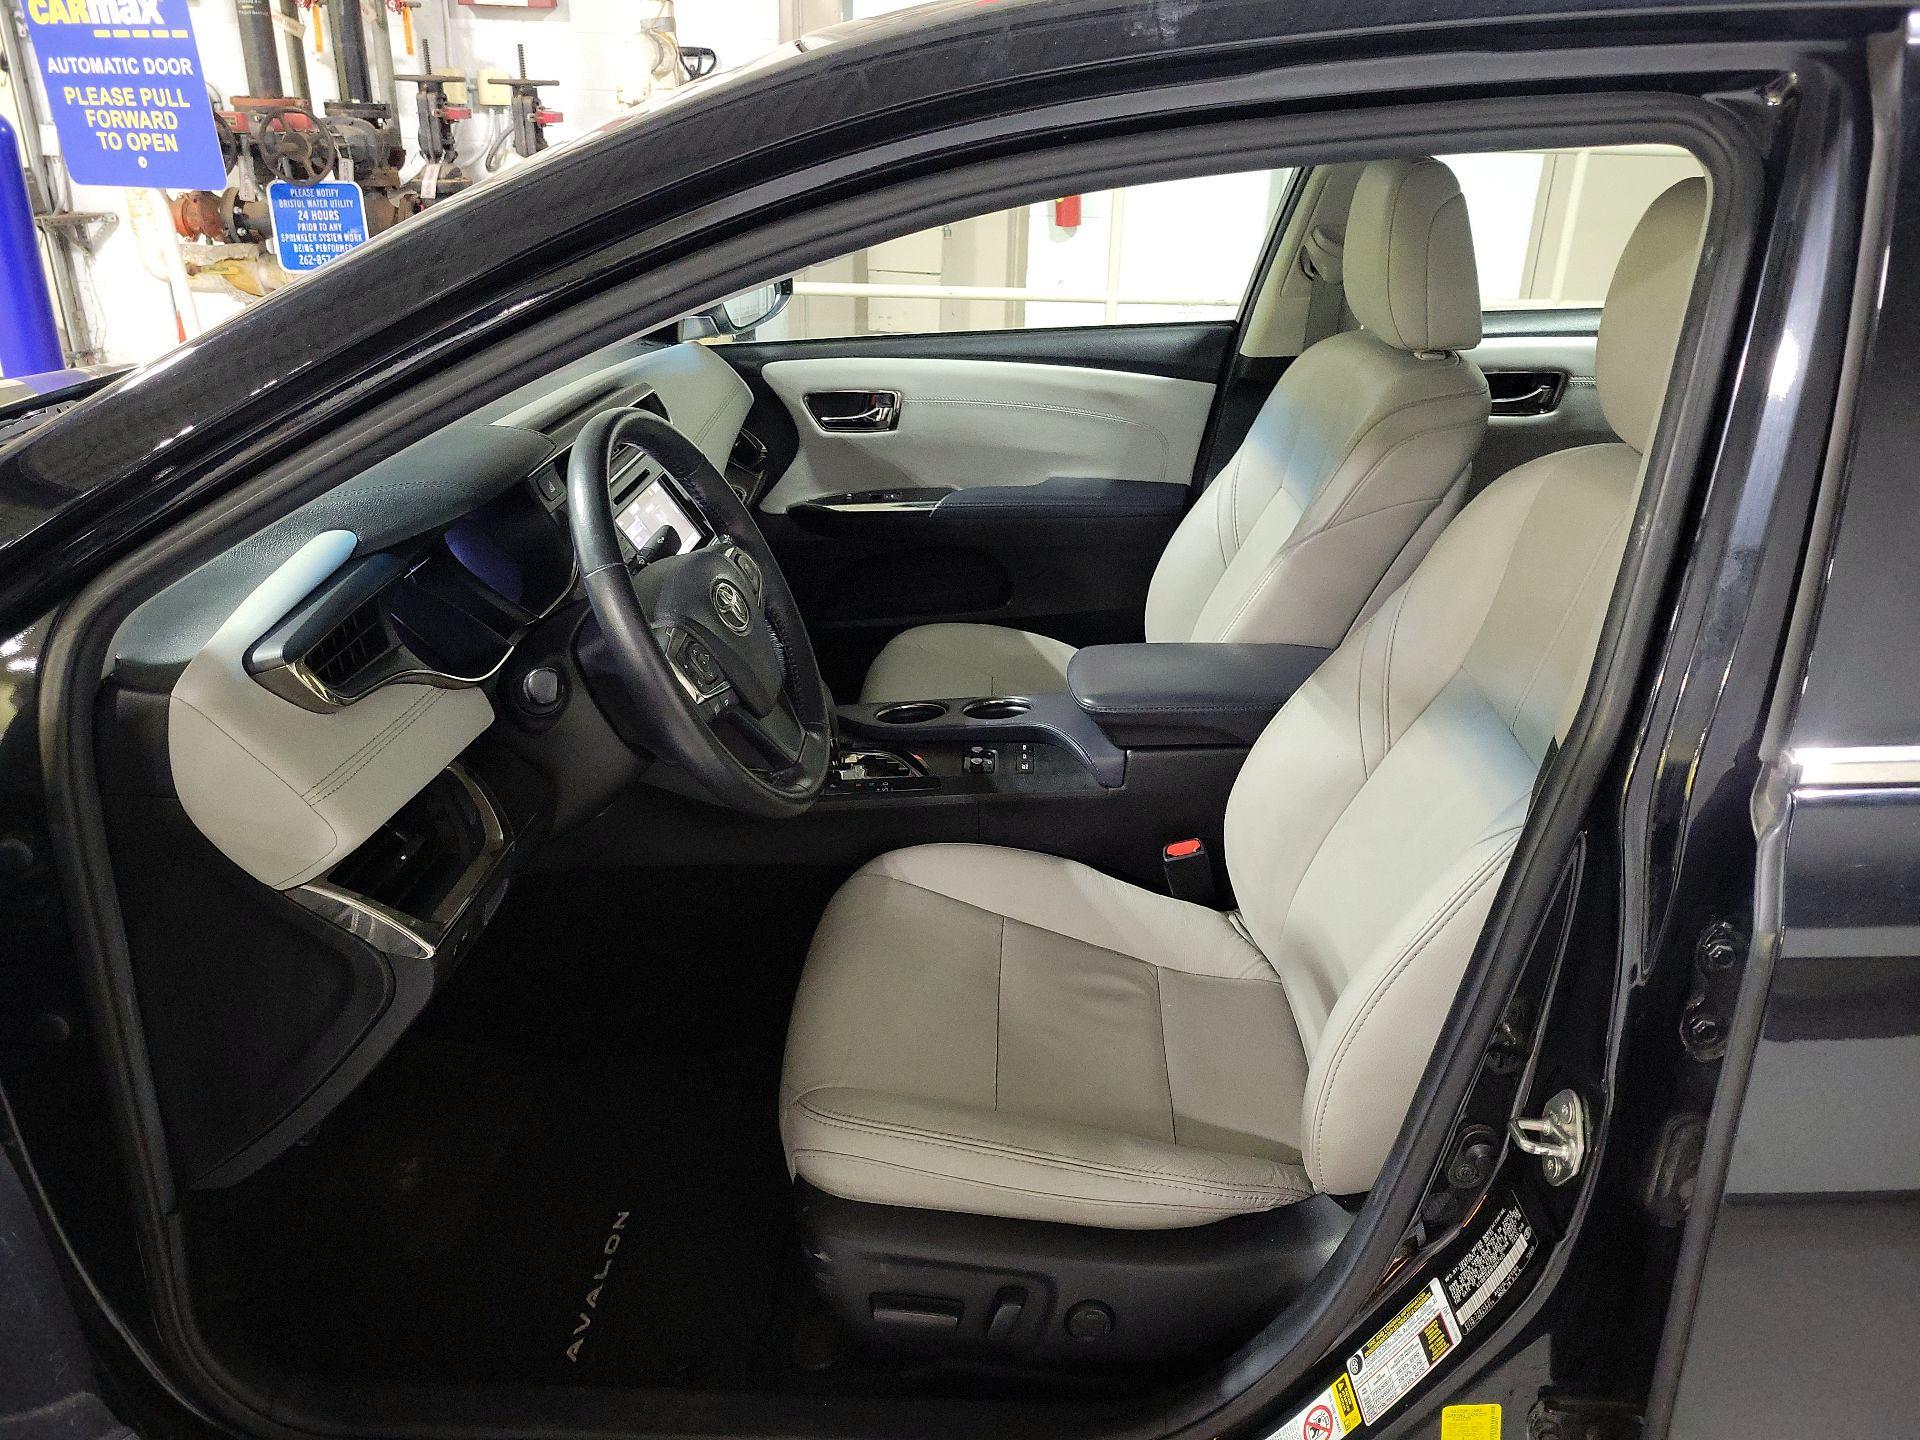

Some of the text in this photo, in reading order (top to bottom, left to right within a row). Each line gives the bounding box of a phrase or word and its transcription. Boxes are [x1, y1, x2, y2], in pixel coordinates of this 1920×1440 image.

[48, 57, 194, 76] AUTOMATIC DOOR
[64, 86, 190, 108] PLEASE PULL
[85, 109, 178, 130] FORWARD
[96, 131, 179, 153] TO OPEN
[290, 188, 339, 198] PLEASE NOTIFY
[279, 199, 354, 208] BRISTOL WATER UTILITY
[298, 210, 340, 221] 24 HOURS
[298, 223, 342, 232] PRIOR TO ANY
[281, 233, 363, 242] SPRINKLER SYSTEM WORK
[293, 244, 314, 253] BEING
[566, 1211, 630, 1363] AVALON
